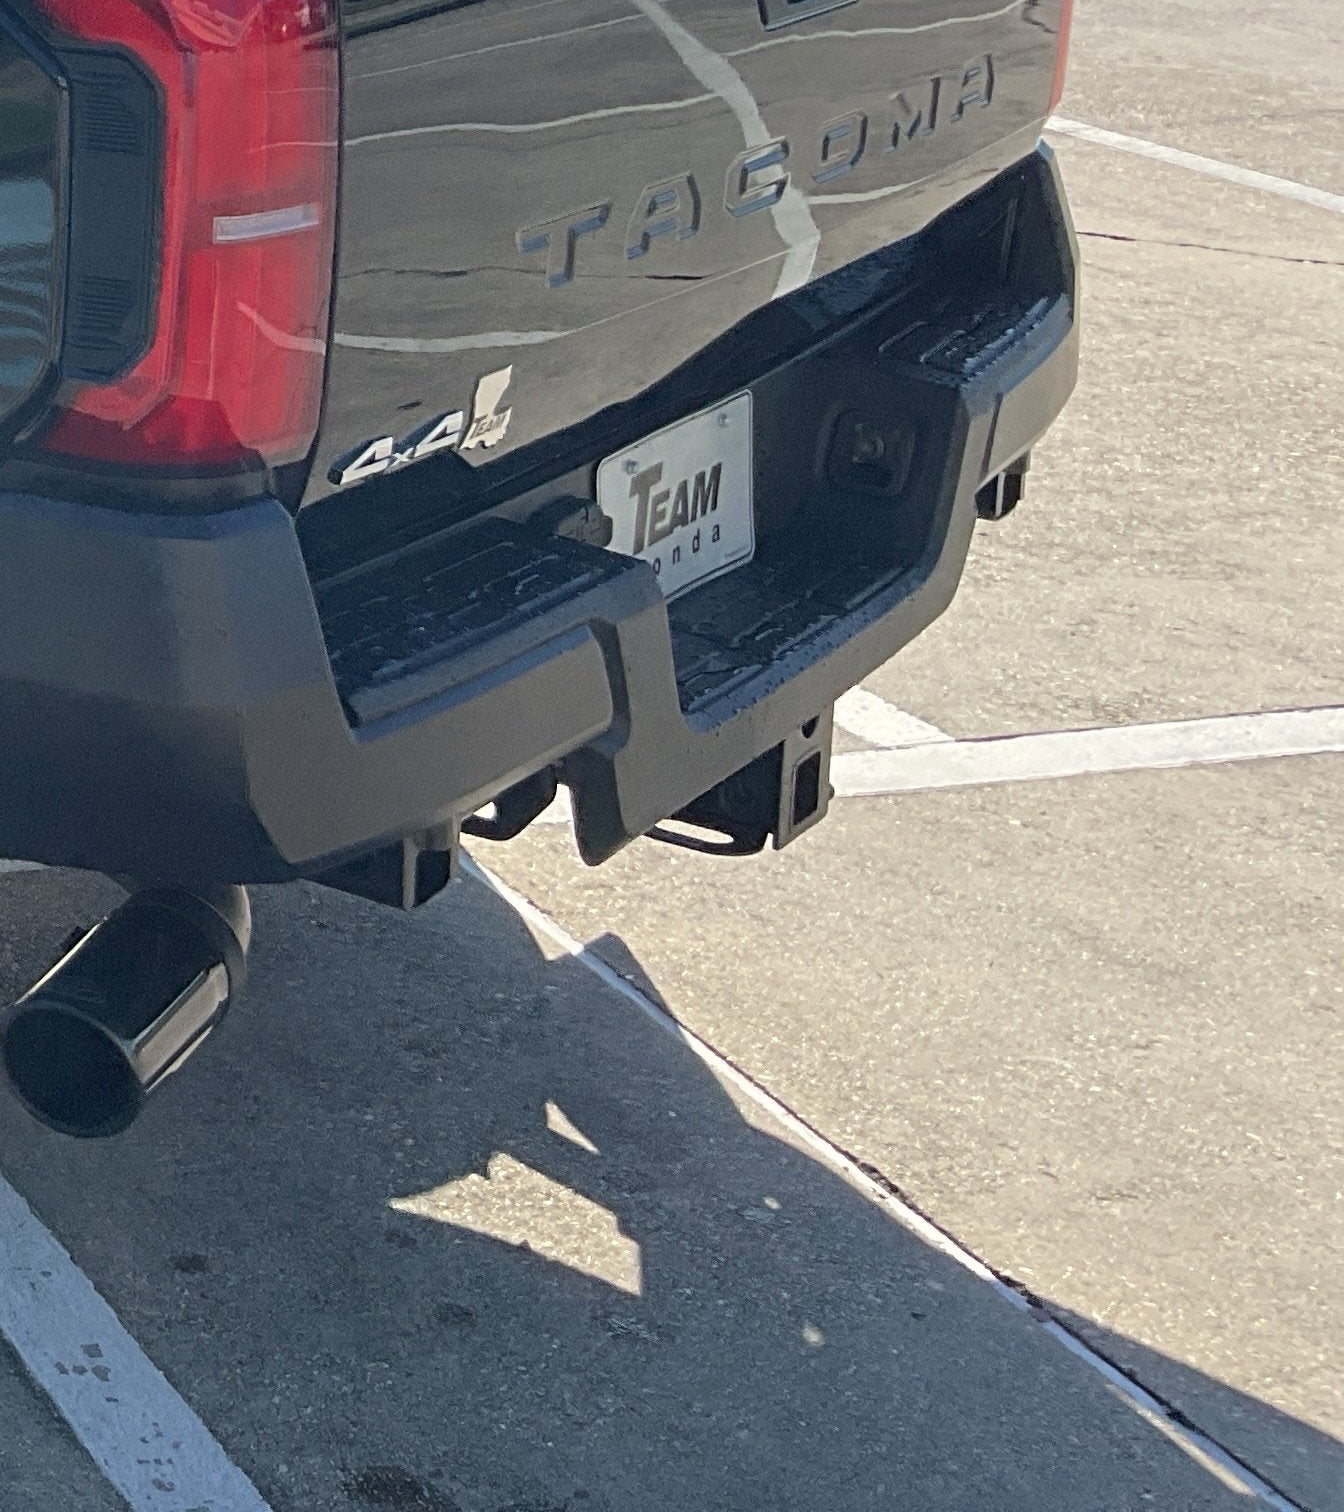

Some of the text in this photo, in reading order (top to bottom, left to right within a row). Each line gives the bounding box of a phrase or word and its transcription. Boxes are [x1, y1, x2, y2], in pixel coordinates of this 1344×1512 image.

[515, 52, 996, 289] TACOMA
[339, 410, 463, 486] 4x4
[470, 414, 507, 440] TEAM
[628, 461, 722, 555] TEAM
[652, 524, 721, 575] onda
